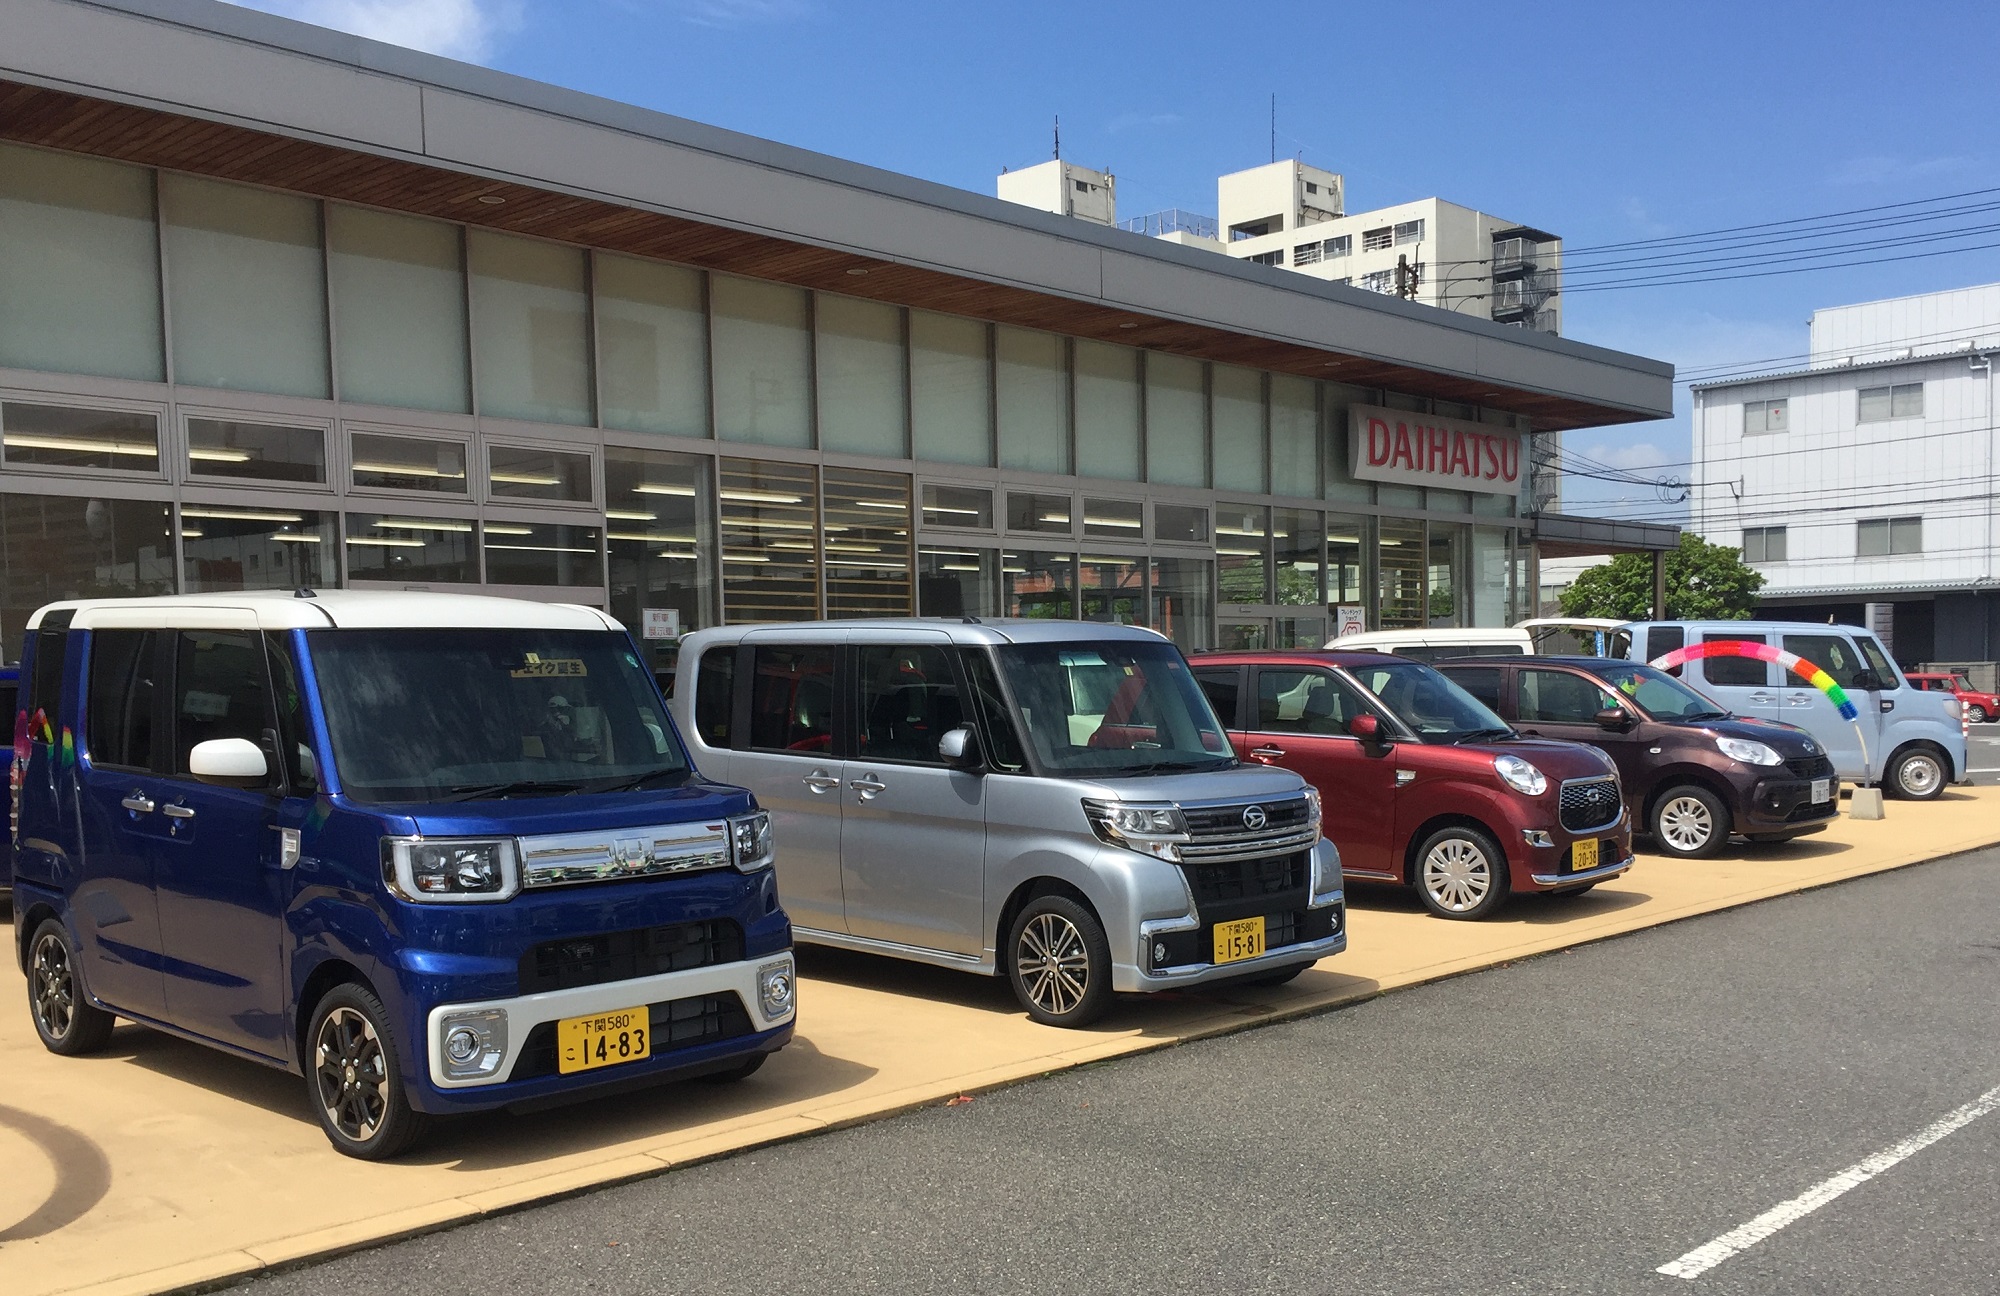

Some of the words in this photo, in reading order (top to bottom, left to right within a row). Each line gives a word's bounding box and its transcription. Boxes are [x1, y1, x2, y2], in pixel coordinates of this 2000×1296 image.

[1366, 417, 1519, 483] DAIHATSU
[648, 626, 674, 636] 展示車
[513, 661, 581, 674] ェイク誕生
[1578, 850, 1597, 867] 20-38
[1227, 933, 1261, 959] 15-81
[566, 1047, 576, 1061] こ
[583, 1028, 645, 1065] 14-83
